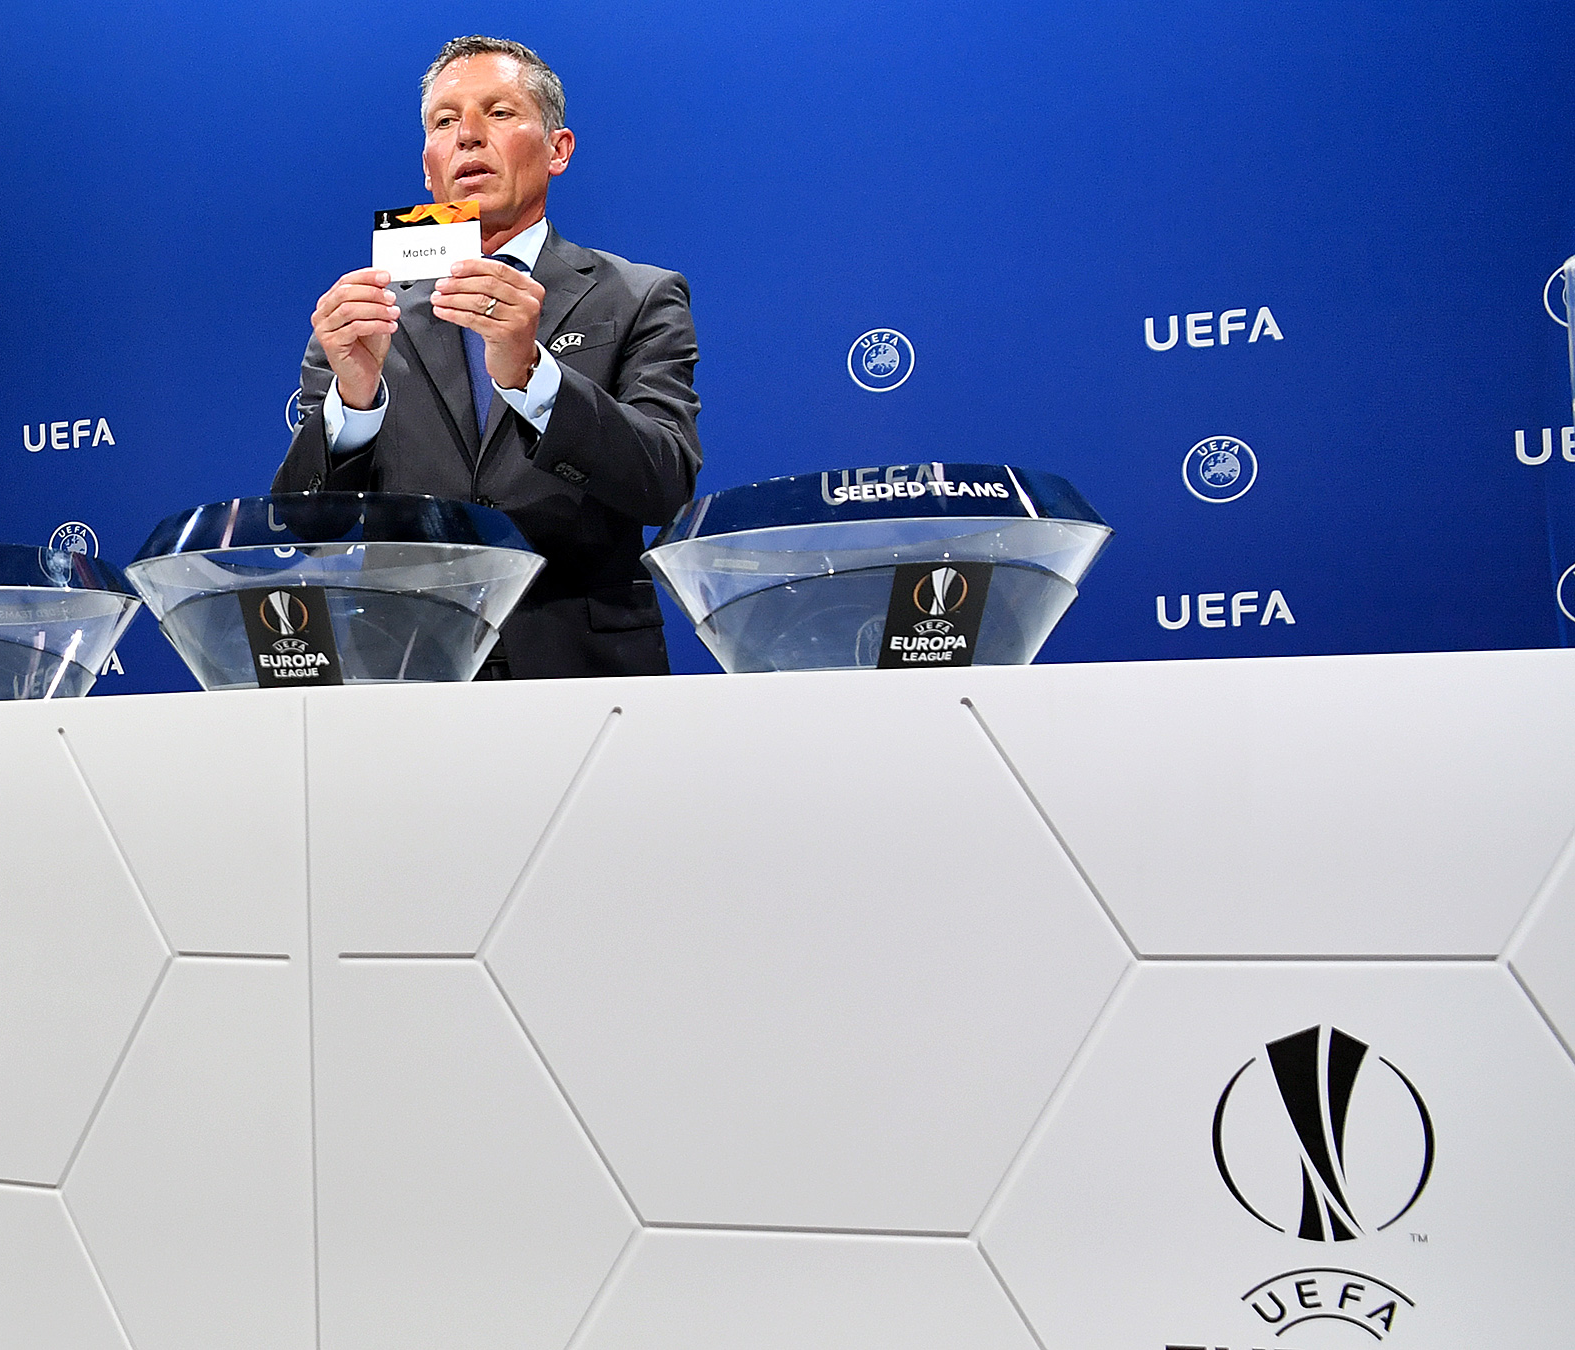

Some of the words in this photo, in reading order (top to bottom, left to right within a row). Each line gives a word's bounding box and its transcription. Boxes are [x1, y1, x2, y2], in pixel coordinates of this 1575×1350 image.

[402, 248, 437, 258] Match
[440, 246, 447, 255] 8
[1144, 306, 1284, 351] UEFA
[551, 335, 582, 352] UEFA
[860, 333, 899, 348] UEFA
[23, 417, 116, 452] UEFA
[1197, 441, 1240, 456] UEFA
[833, 482, 926, 502] SEEDED
[928, 481, 1010, 498] TEAMS
[58, 526, 87, 538] UEFA
[1156, 590, 1296, 630] UEFA
[914, 621, 951, 633] UEFA
[274, 640, 306, 651] UEFA
[890, 635, 967, 650] EUROPA
[259, 652, 330, 667] EUROPA
[902, 651, 953, 661] LEAGUE
[273, 667, 319, 677] LEAGUE
[1409, 1233, 1428, 1243] TM
[1251, 1279, 1398, 1332] UEFA
